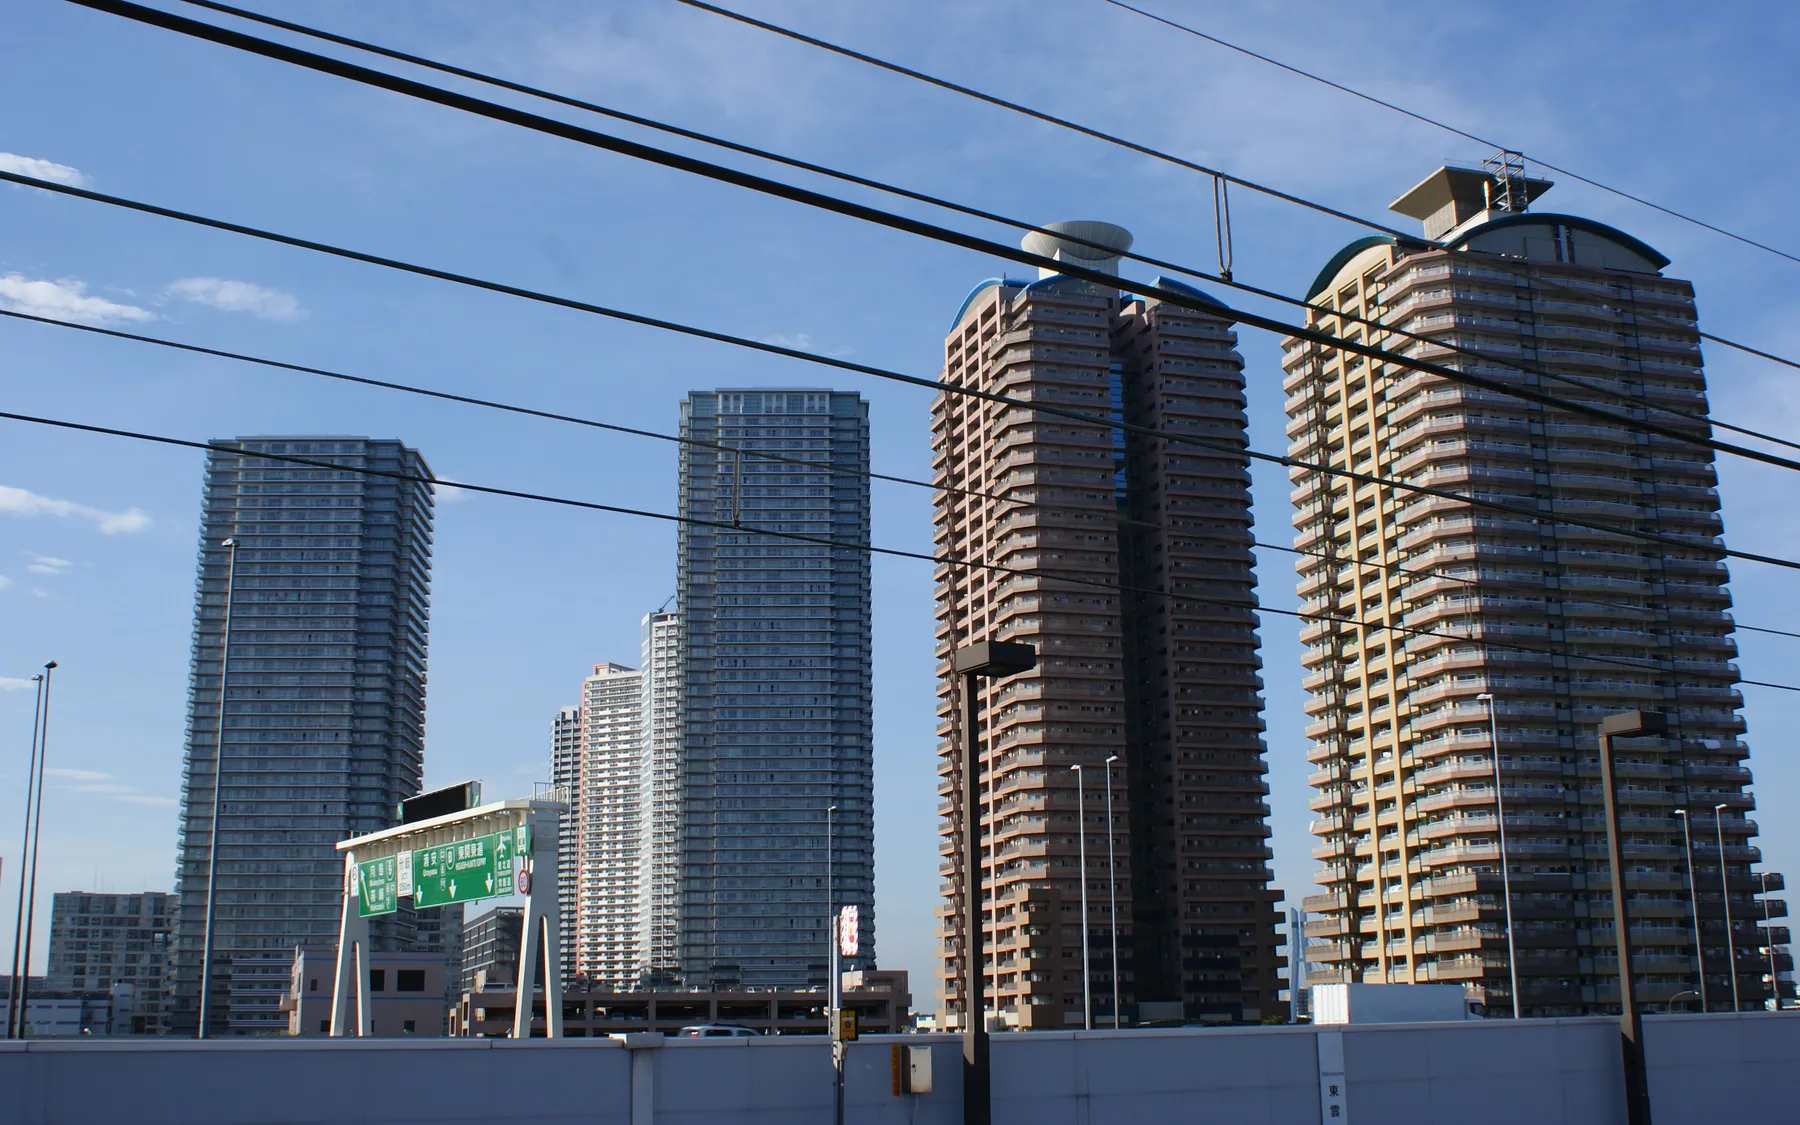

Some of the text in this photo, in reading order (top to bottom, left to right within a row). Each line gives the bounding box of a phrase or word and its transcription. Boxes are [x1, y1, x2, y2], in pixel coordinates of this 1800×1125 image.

[423, 852, 437, 868] 浦安
[458, 843, 483, 860] 東関東道
[1329, 1084, 1340, 1117] 東雲
